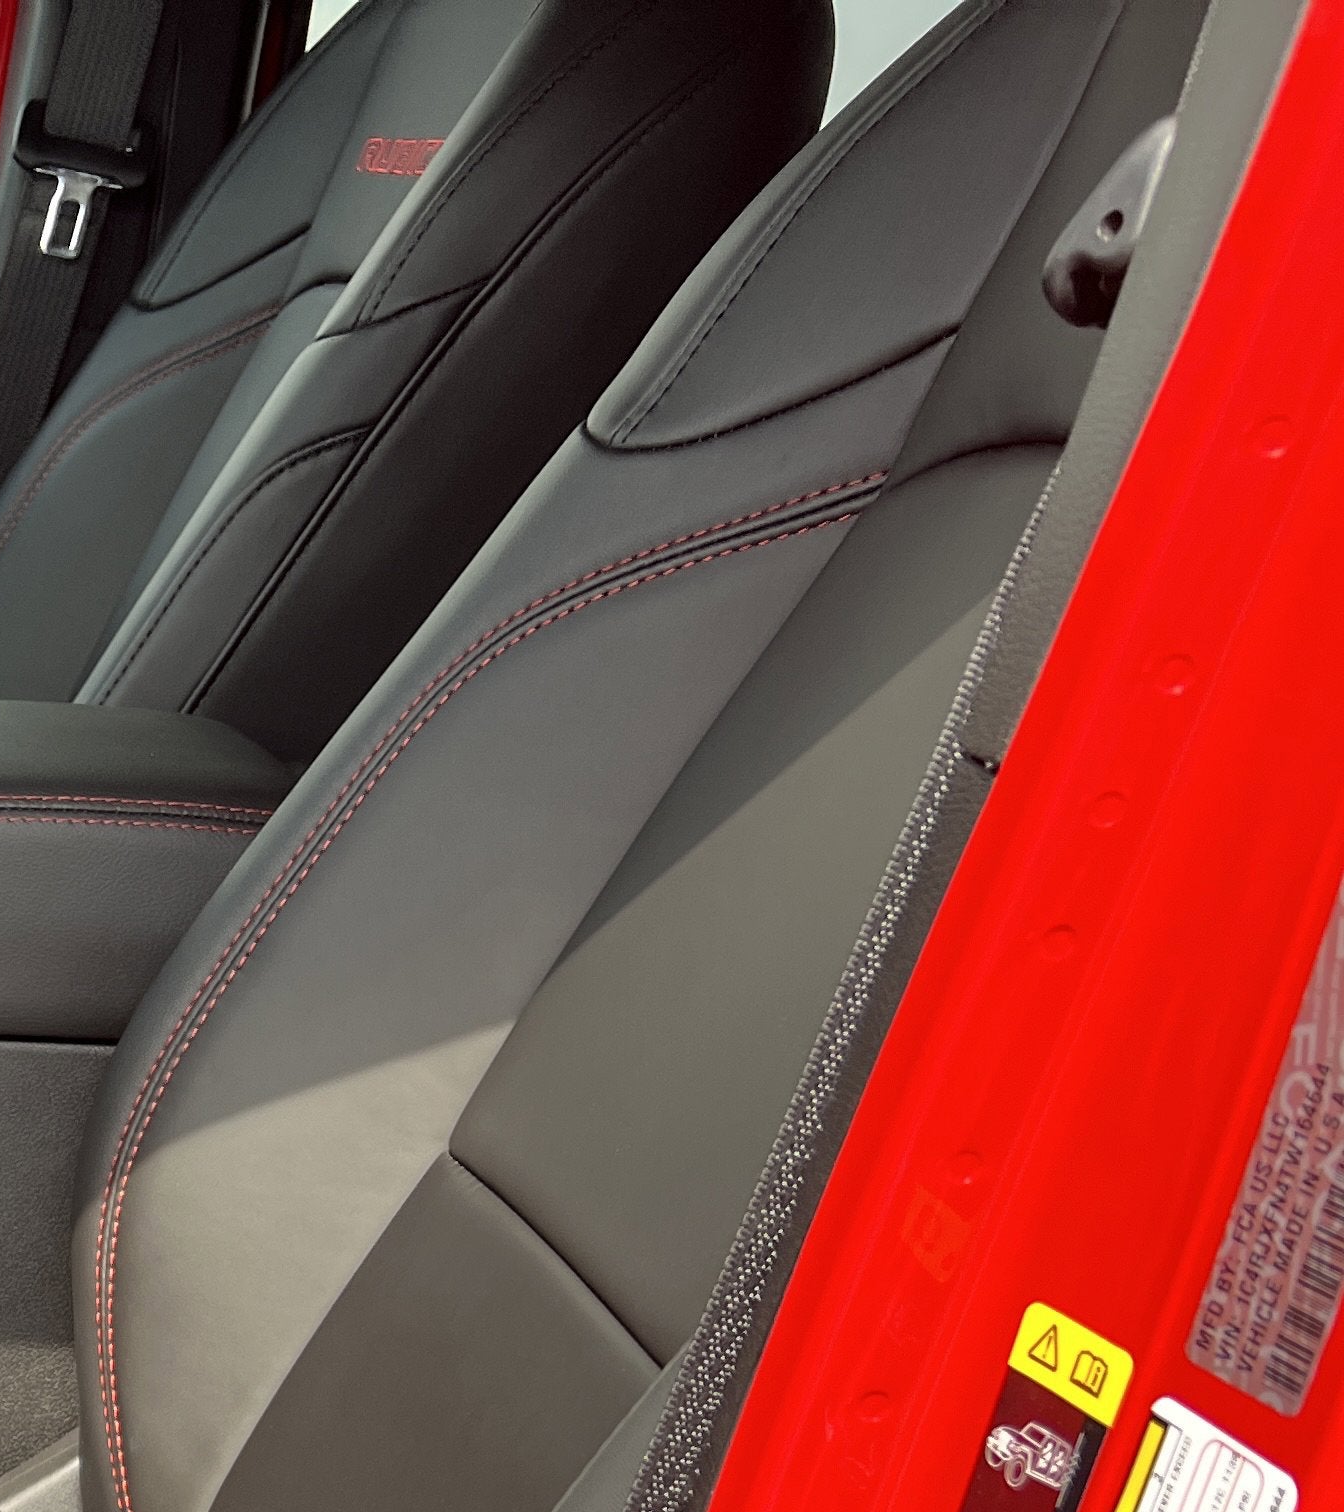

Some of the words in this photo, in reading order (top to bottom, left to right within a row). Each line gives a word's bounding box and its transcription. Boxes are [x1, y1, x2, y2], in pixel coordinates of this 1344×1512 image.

[1231, 1198, 1258, 1247] FCA
[1248, 1159, 1273, 1195] US
[1261, 1110, 1290, 1155] LLC
[1236, 1276, 1282, 1374] VEHICLE
[1272, 1199, 1310, 1274] MADE
